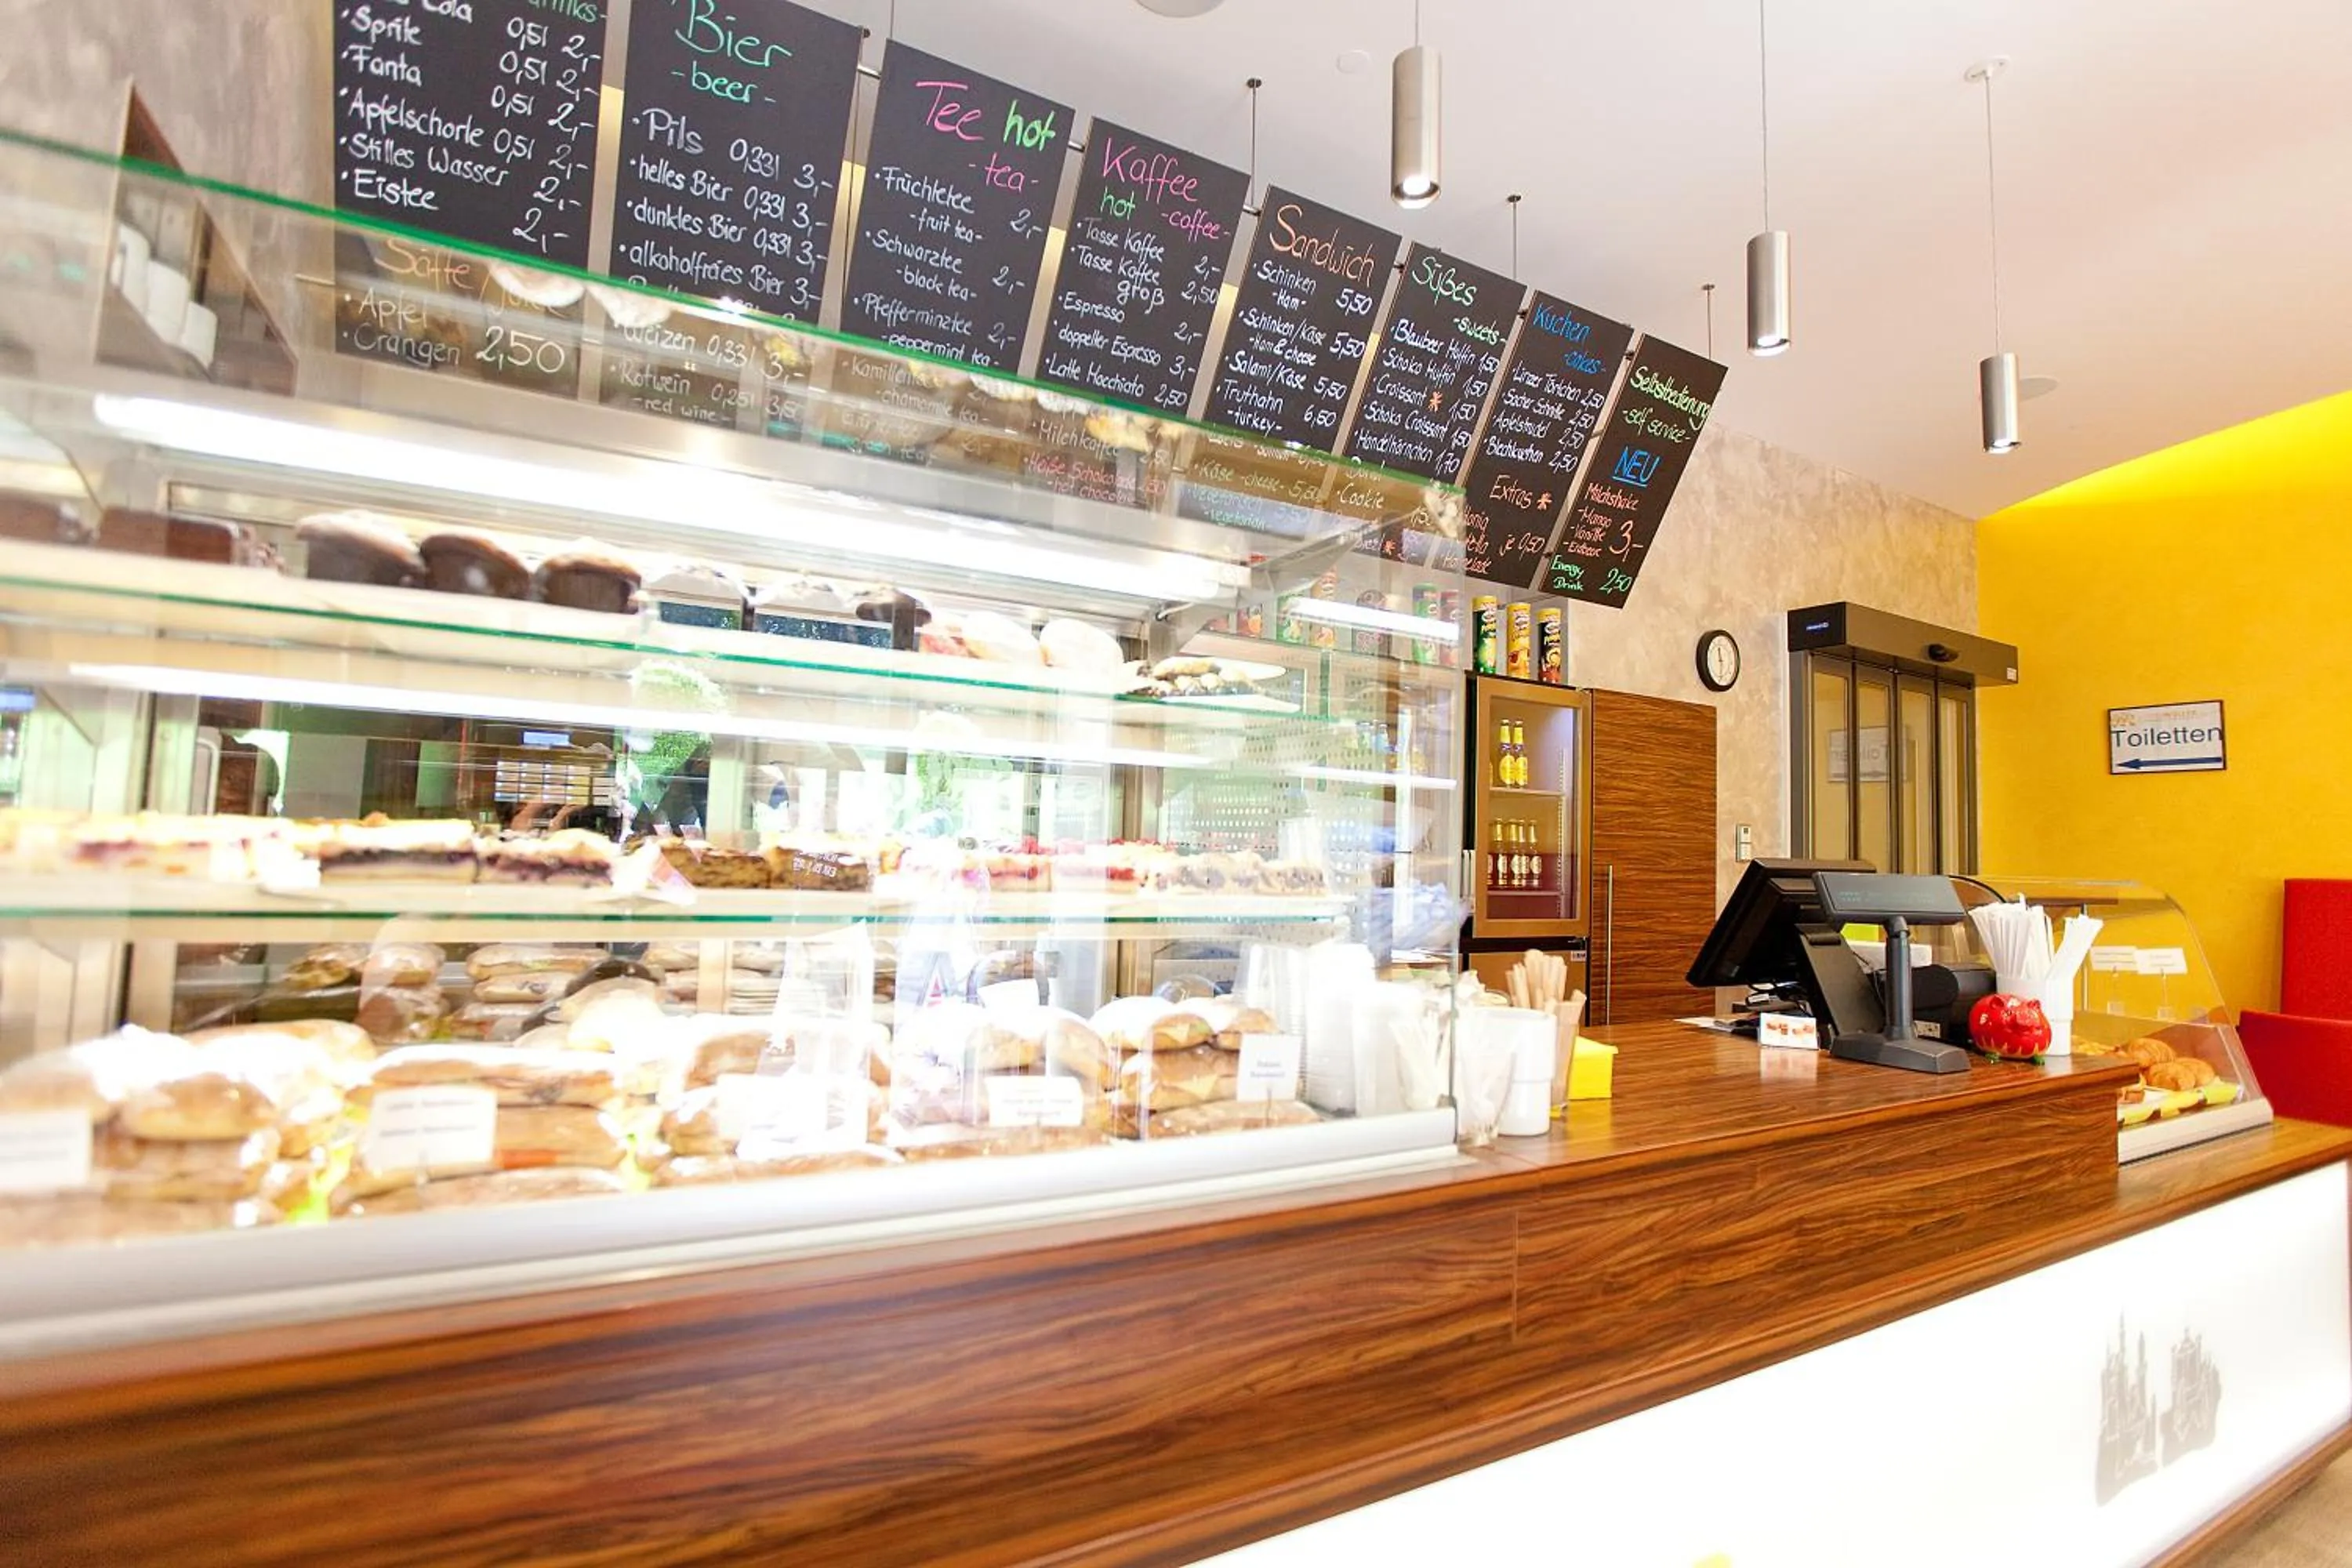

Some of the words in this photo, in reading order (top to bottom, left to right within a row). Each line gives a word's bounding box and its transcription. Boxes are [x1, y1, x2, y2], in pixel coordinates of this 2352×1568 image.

[350, 5, 423, 45] Sprite
[674, 0, 793, 67] Bier
[348, 44, 423, 87] Fanta
[348, 87, 485, 147] Apfelschorle
[642, 107, 704, 154] Pils
[915, 81, 985, 141] Tee
[1003, 99, 1056, 152] hot
[348, 132, 415, 169] Stilles
[427, 146, 510, 186] Wasser
[638, 154, 685, 191] helles
[689, 169, 733, 202] Bier
[1102, 137, 1198, 204] Kaffee
[353, 168, 440, 211] Eistee
[1100, 187, 1136, 220] hot
[633, 198, 703, 235] dunkles
[707, 213, 747, 244] Bier
[1083, 218, 1119, 247] Tasse
[1123, 228, 1166, 263] Kaffee
[872, 229, 964, 274] Schwarztee
[1076, 245, 1113, 274] Tasse
[1117, 256, 1160, 289] Kaffee
[1269, 204, 1374, 288] Sandwich
[748, 264, 785, 296] Bier
[1116, 280, 1165, 314] groß
[1181, 281, 1219, 305] 2,50
[1257, 260, 1317, 296] Schinken
[1336, 288, 1373, 316] 5,50
[1412, 256, 1477, 307] Süßes
[358, 287, 427, 331] Apfel
[862, 292, 973, 336] Pfefferminztee
[1062, 291, 1125, 323] Espresso
[1533, 302, 1592, 343] Kuchen
[476, 325, 565, 373] 2,50
[1059, 325, 1109, 350] doppelter
[1111, 336, 1161, 366] Espresso
[1330, 332, 1366, 361] 5,50
[1446, 339, 1475, 372] Muffin
[619, 361, 691, 396] Rotwein
[1048, 353, 1080, 381] Latte
[1154, 383, 1188, 408] 2,50
[1313, 376, 1347, 401] 5,50
[1383, 348, 1423, 375] Schoko
[1425, 358, 1456, 388] Muffin
[1224, 379, 1283, 414] Truthahn
[1304, 405, 1337, 428] 6,50
[1376, 373, 1427, 406] Croissant
[1365, 401, 1402, 426] Schoko
[1405, 410, 1450, 442] Croissant
[1548, 451, 1578, 474] 2,50
[1614, 445, 1662, 481] NEU
[1340, 483, 1385, 509] Cookie
[1490, 474, 1534, 510] Extras
[1551, 554, 1584, 579] Energy
[1553, 576, 1584, 592] Drink
[1599, 568, 1633, 594] 2,50
[2111, 727, 2223, 747] Toiletten
